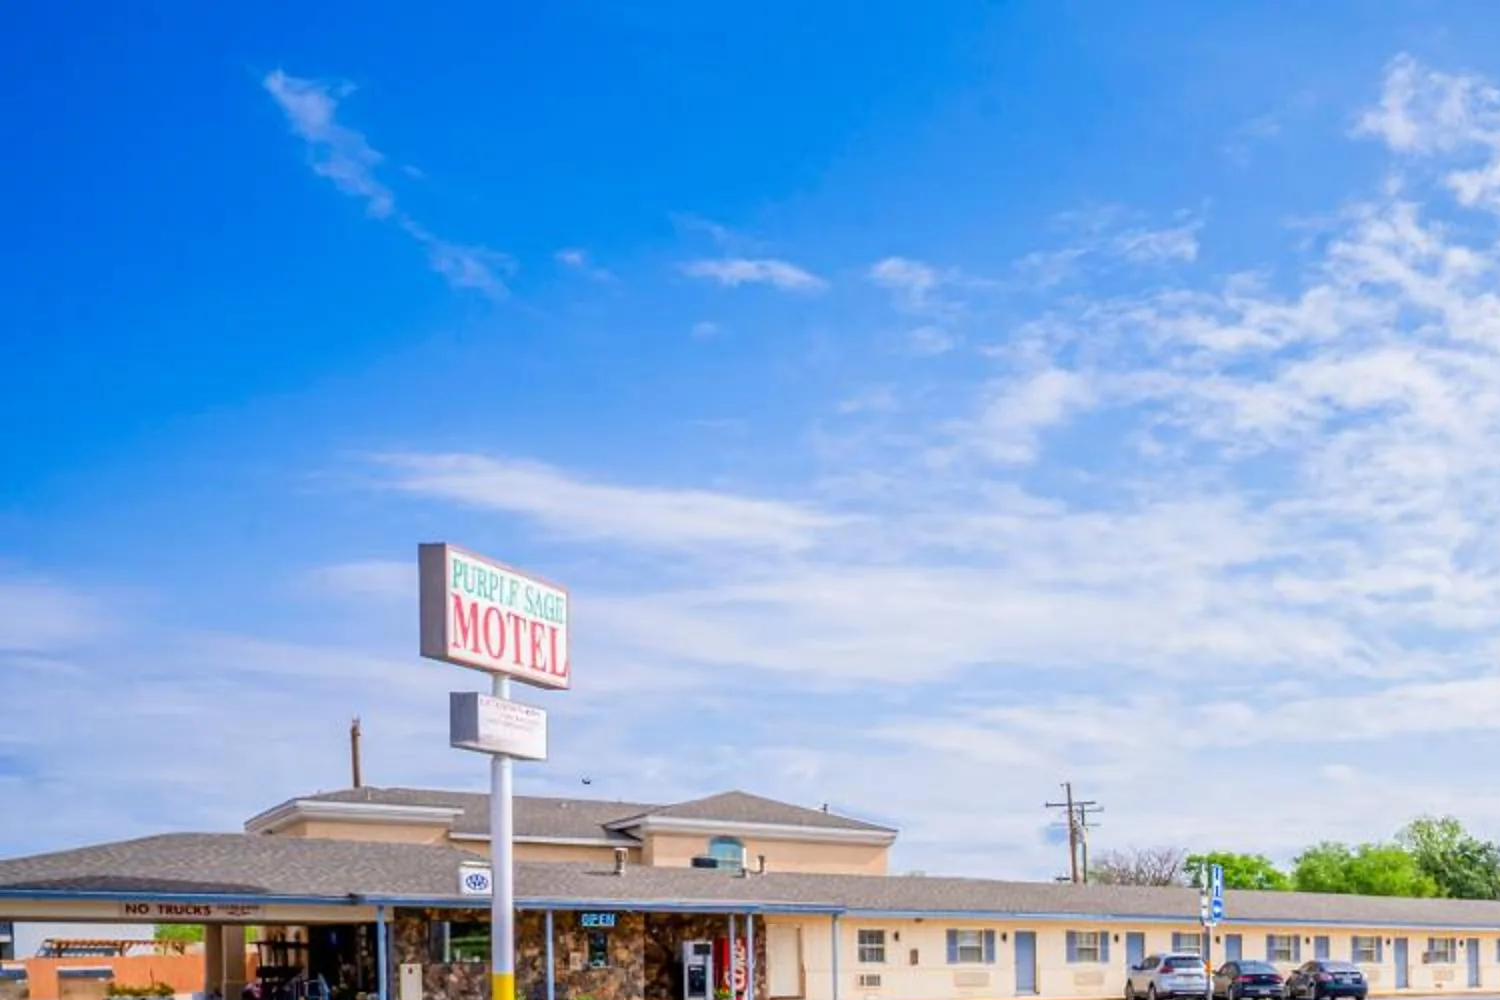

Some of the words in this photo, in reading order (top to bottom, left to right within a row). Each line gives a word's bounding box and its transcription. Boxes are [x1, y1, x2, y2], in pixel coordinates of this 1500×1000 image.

[451, 558, 520, 606] PURPLE
[524, 584, 565, 625] SAGE
[451, 591, 569, 677] MOTEL
[125, 903, 149, 914] NO
[157, 903, 211, 916] TRUCKS
[581, 912, 615, 927] OPEN
